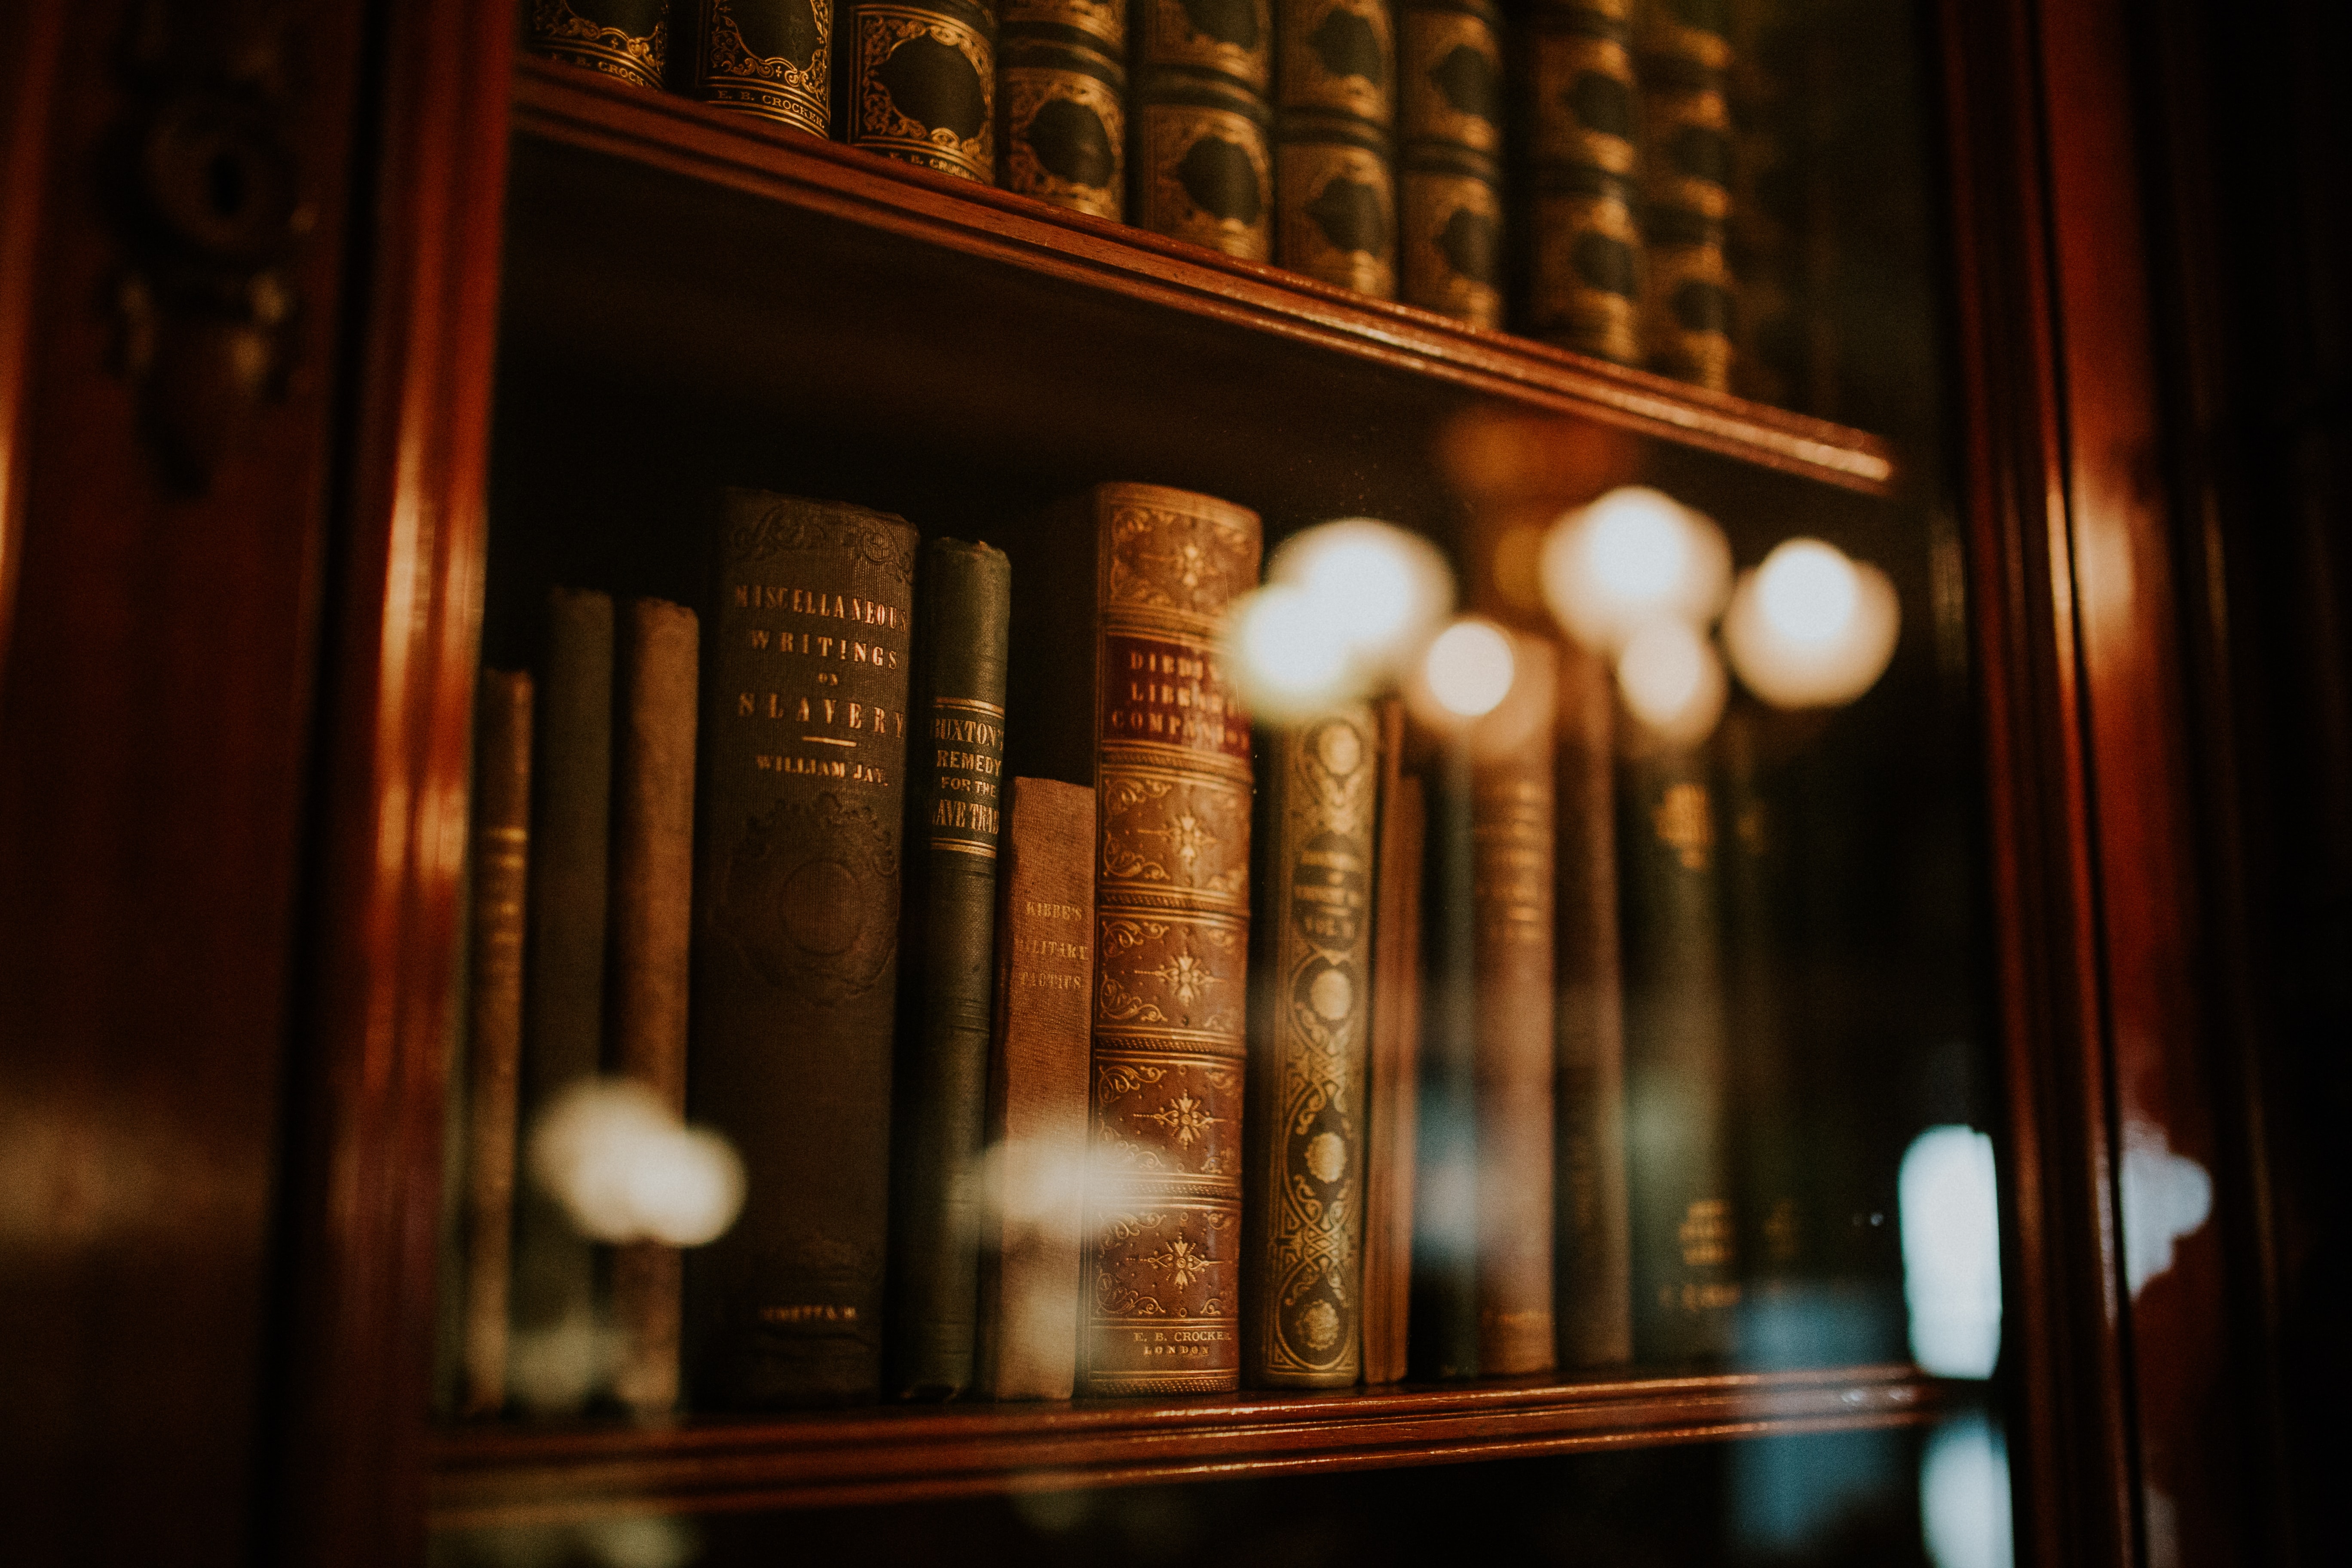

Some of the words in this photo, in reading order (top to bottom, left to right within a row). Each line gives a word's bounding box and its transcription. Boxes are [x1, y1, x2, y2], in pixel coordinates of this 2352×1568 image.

[717, 90, 732, 99] E.
[741, 91, 754, 101] B.
[762, 95, 825, 129] CROCKER.
[735, 585, 906, 632] MISCELLANEOUS
[752, 630, 897, 669] WRITINGS
[739, 692, 903, 738] SLAVERY
[756, 755, 845, 778] WILLIAM
[937, 750, 1001, 776] REMEDY
[941, 776, 971, 791] FOR
[975, 781, 996, 797] THE
[1134, 1332, 1148, 1342] E.
[1155, 1332, 1168, 1342] B.
[1144, 1346, 1210, 1356] LONDON
